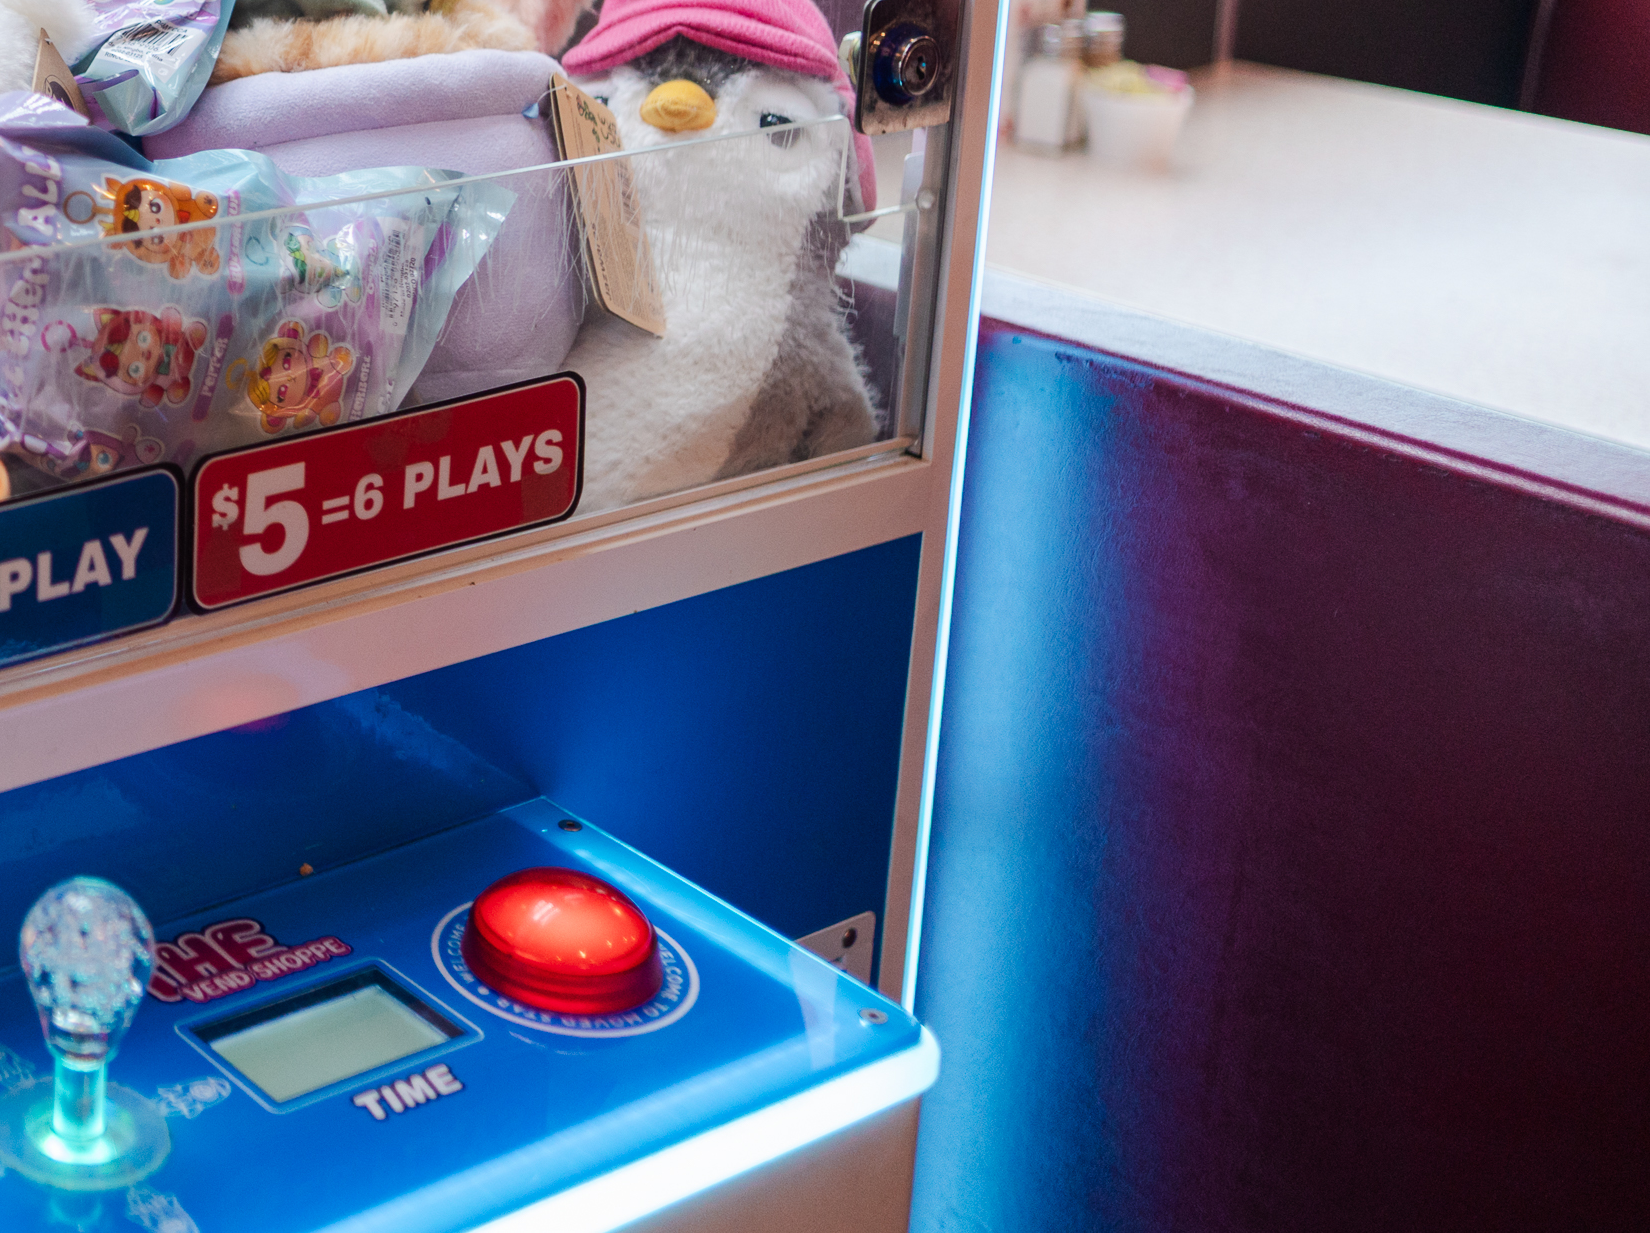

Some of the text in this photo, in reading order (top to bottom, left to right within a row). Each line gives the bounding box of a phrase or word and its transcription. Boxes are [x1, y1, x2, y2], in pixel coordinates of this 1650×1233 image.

[403, 429, 564, 509] PLAYS
[183, 936, 350, 1002] VEND SHOPPE
[353, 1063, 464, 1121] TIME
